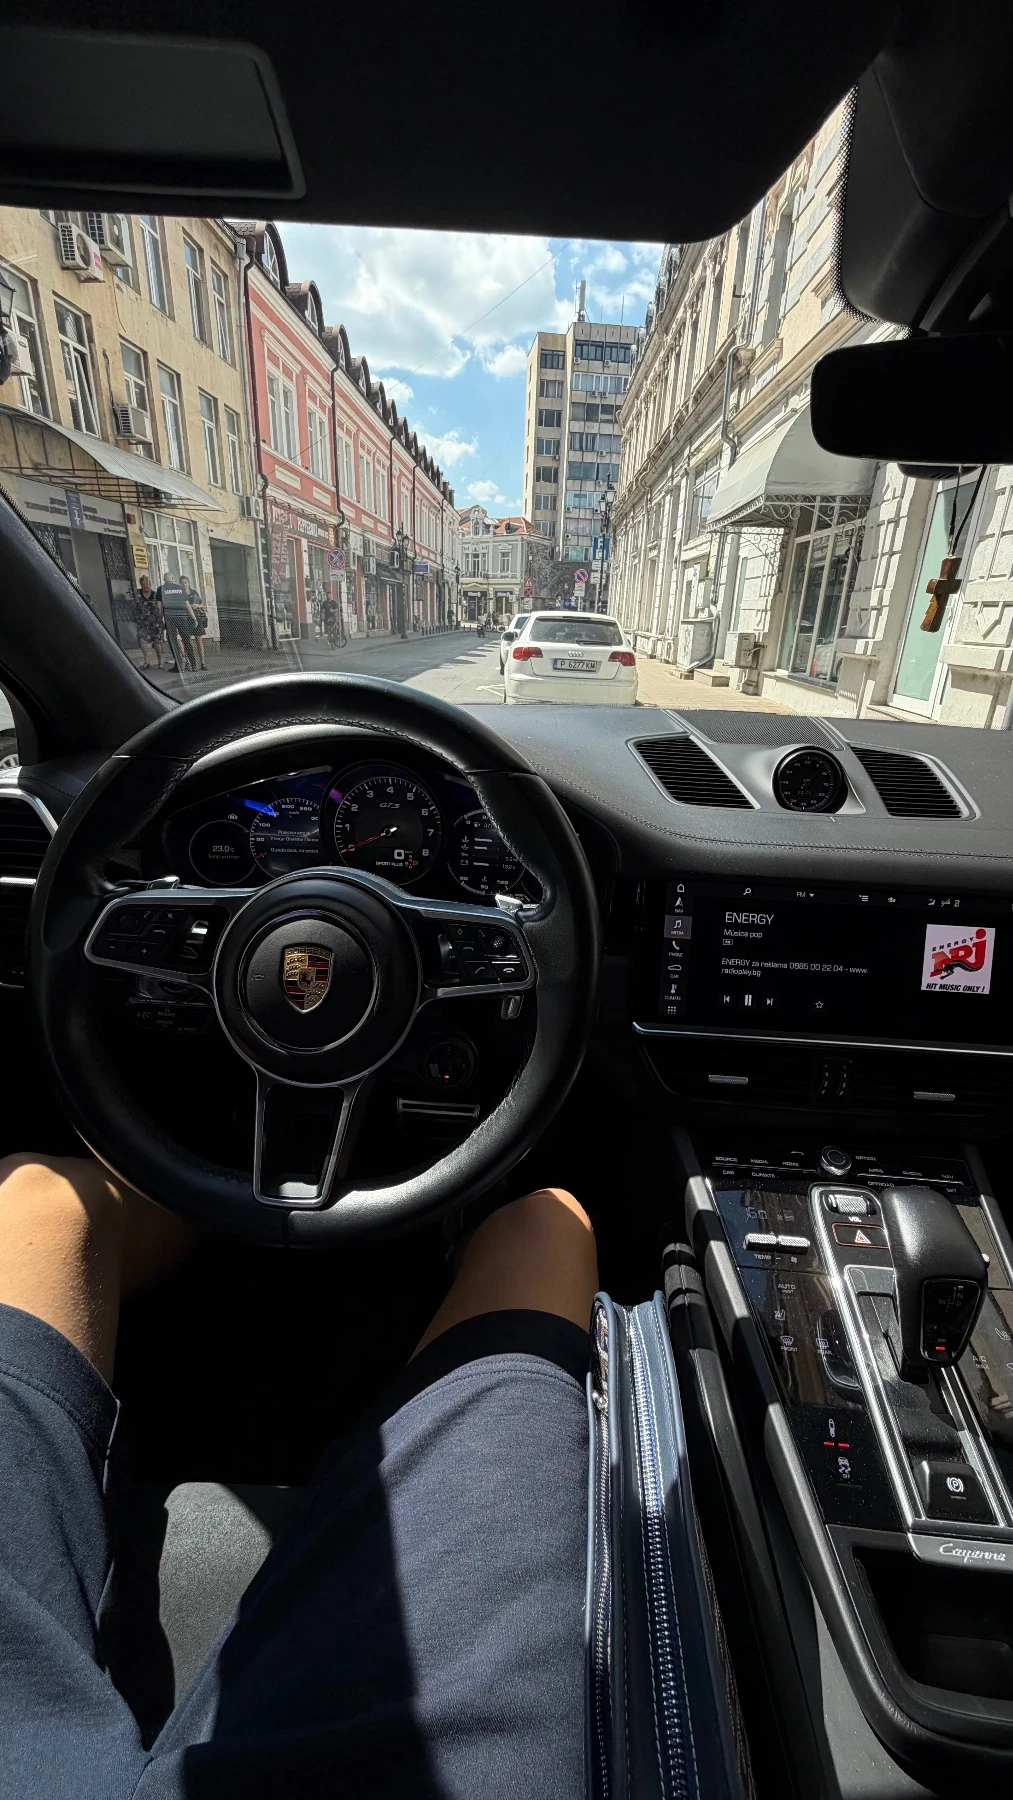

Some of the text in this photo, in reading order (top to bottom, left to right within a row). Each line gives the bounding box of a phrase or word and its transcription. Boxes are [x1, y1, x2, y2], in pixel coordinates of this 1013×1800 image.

[394, 849, 404, 860] 0
[725, 912, 774, 925] ENERGY
[724, 929, 748, 938] Música
[932, 936, 974, 951] ENERGY
[722, 958, 750, 966] ENERGY
[721, 968, 761, 977] radioplay.bg
[939, 1543, 1006, 1563] Cayenne
